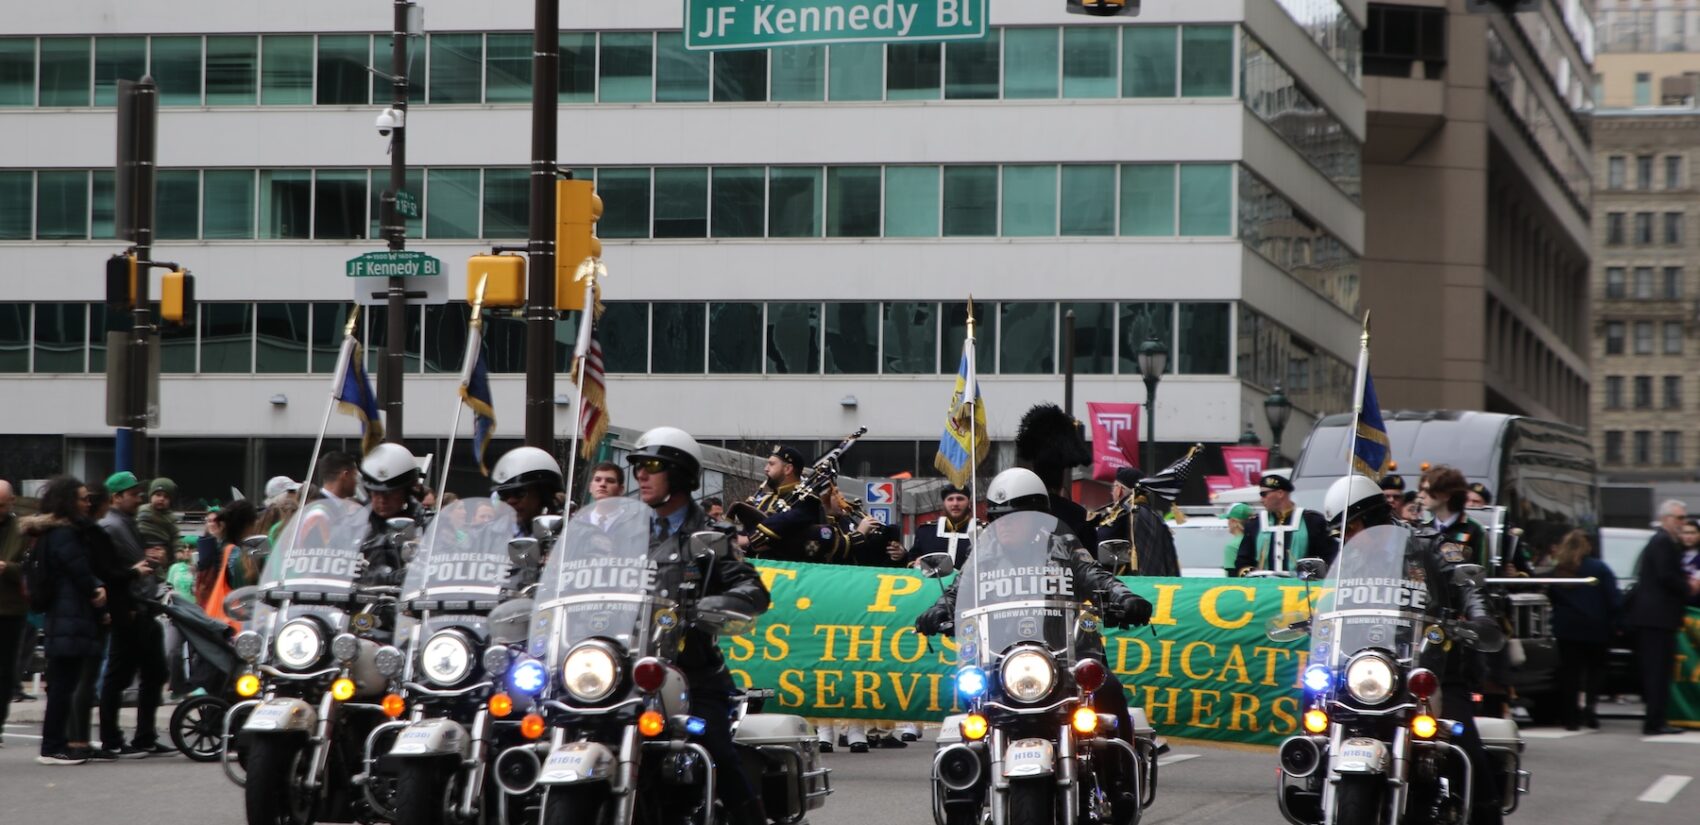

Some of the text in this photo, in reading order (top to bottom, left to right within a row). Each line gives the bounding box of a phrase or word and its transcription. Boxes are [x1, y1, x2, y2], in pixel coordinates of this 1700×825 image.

[698, 0, 972, 38] JF Kennedy Bl
[349, 260, 437, 276] JF Kennedy Bl
[282, 556, 362, 577] POLICE
[426, 561, 512, 583] POLICE
[561, 557, 658, 571] PHILADELPHIA
[558, 567, 657, 592] POLICE
[980, 566, 1073, 581] PHILADELPHIA
[980, 576, 1074, 601] POLICE
[1340, 577, 1427, 591] PHILADELPHIA
[1337, 585, 1428, 610] POLICE
[993, 608, 1062, 619] HIGHWAY PATROL
[1014, 751, 1041, 760] H165
